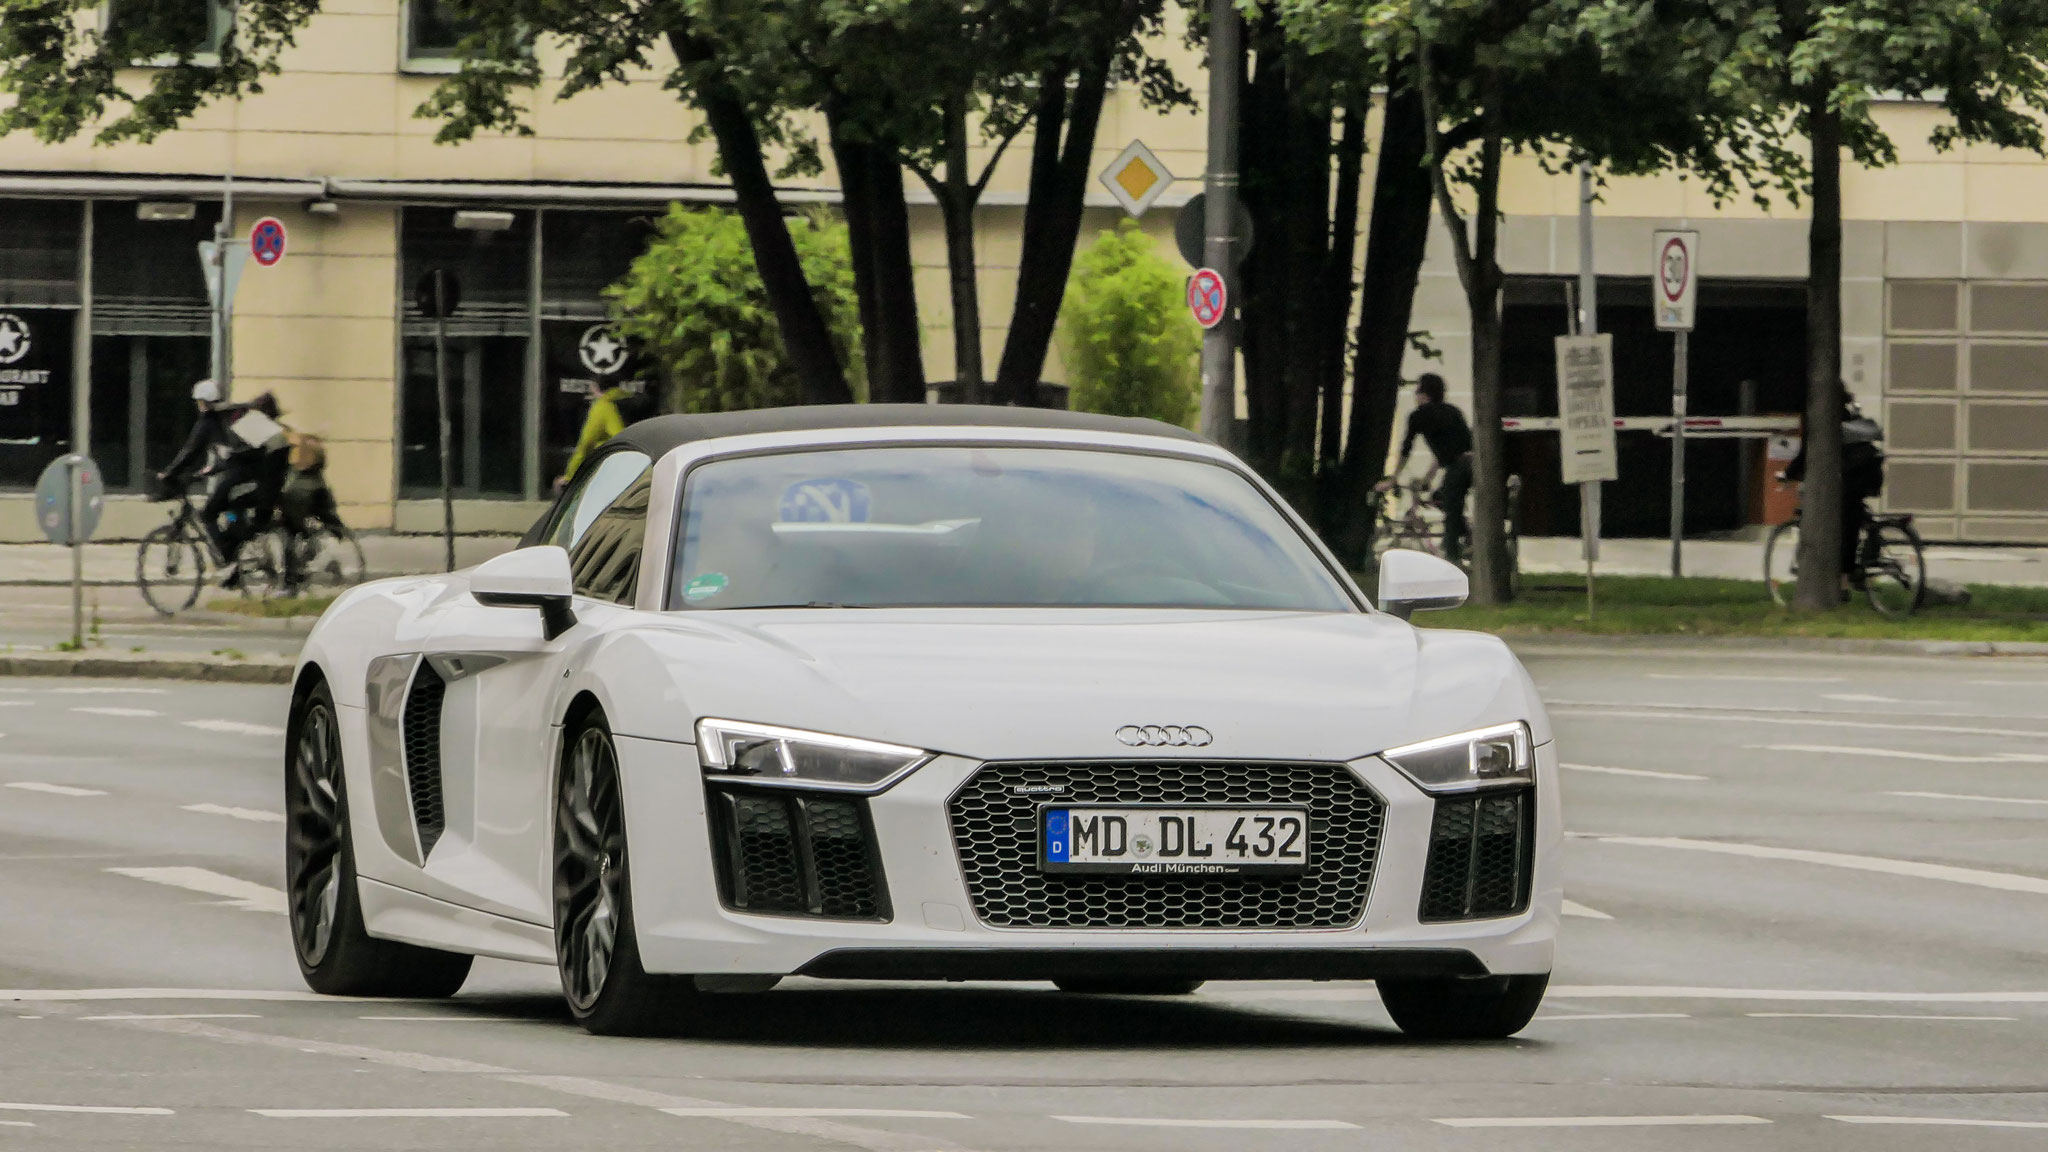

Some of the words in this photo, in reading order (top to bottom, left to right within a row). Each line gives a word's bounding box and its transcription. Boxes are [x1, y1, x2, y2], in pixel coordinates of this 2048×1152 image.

[1016, 785, 1063, 793] quattro
[1052, 841, 1062, 854] D
[1072, 815, 1128, 857] MD
[1158, 816, 1213, 858] DL
[1225, 816, 1302, 858] 432
[1131, 863, 1162, 873] Audi
[1165, 863, 1224, 873] München
